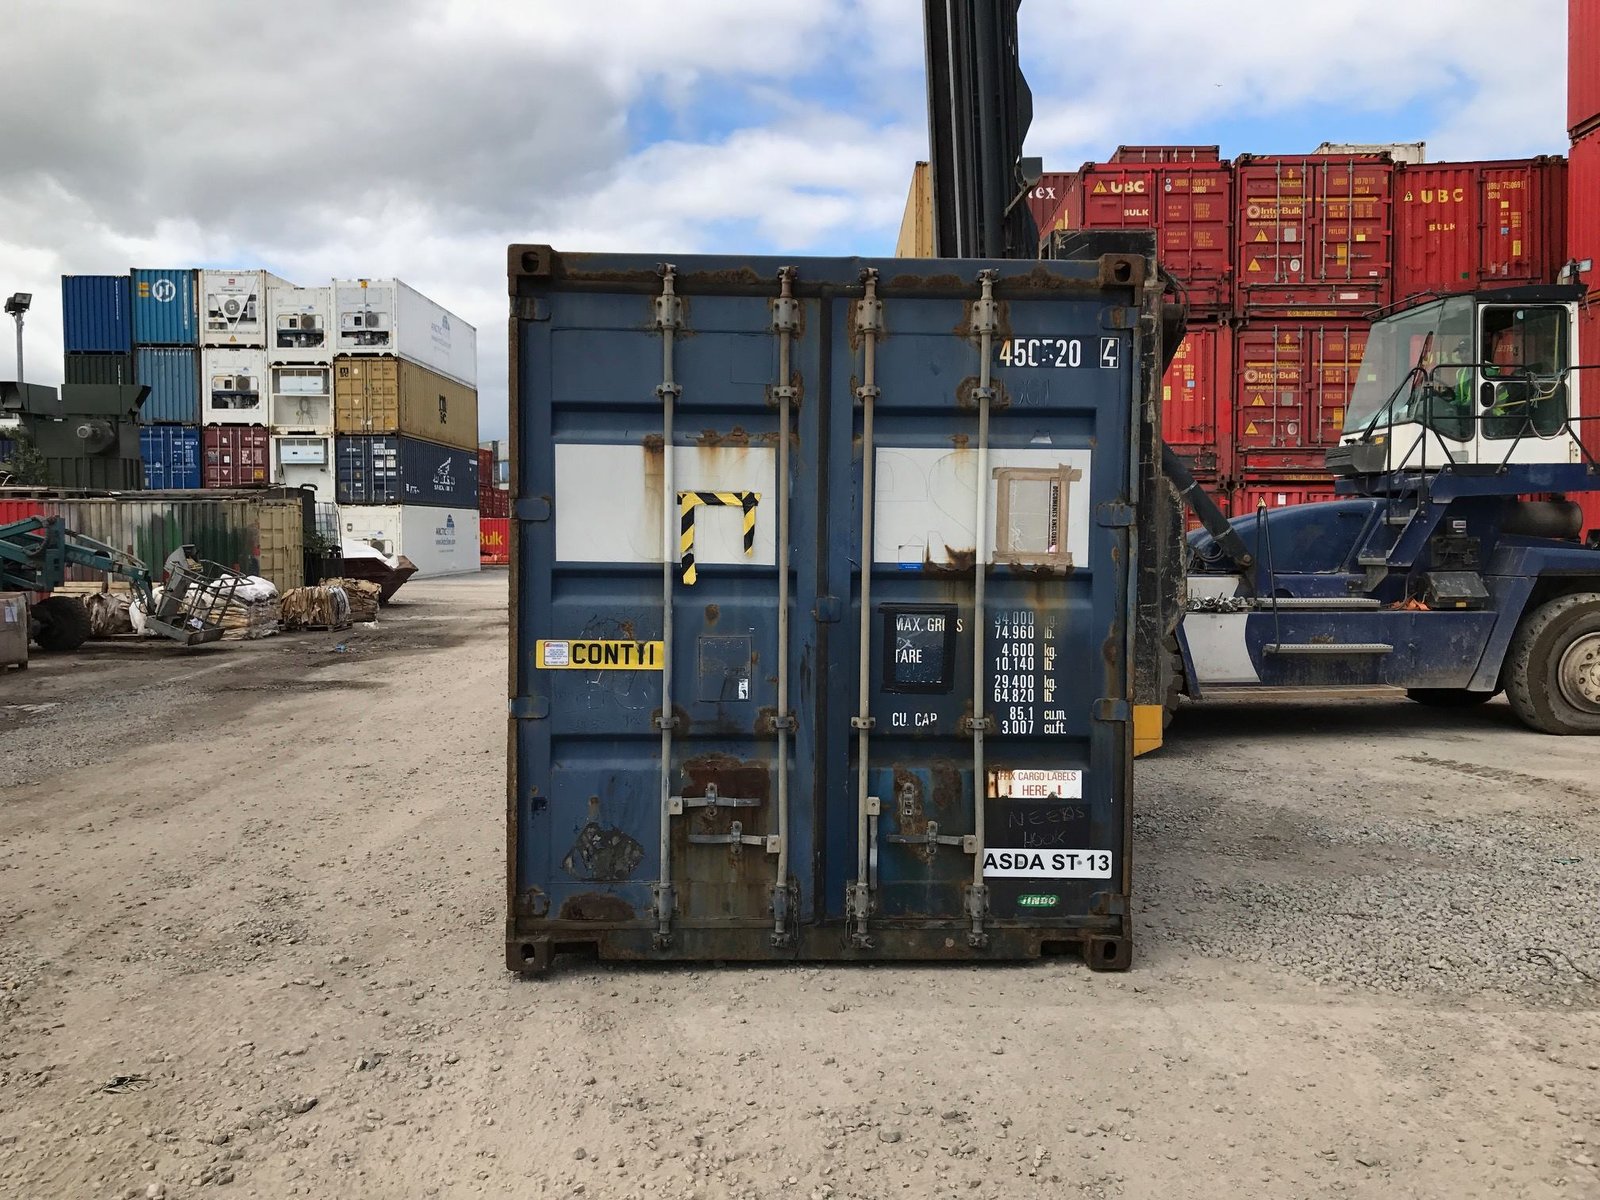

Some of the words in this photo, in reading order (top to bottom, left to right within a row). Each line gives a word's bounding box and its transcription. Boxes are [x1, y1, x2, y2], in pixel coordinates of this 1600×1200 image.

[1110, 180, 1145, 194] UBC
[1420, 188, 1464, 203] UBC
[1123, 208, 1149, 217] BULK
[1260, 206, 1302, 215] InterBulk
[1428, 223, 1456, 231] BULK
[1102, 339, 1117, 367] 4
[1258, 371, 1299, 380] InterBulk
[1051, 485, 1059, 518] DOCUMENTS
[994, 611, 1034, 626] 34.000
[994, 625, 1034, 639] 74.960
[1043, 626, 1055, 639] lb.
[895, 649, 922, 664] TARE
[1001, 642, 1034, 657] 4.600
[1043, 643, 1058, 661] kg.
[995, 656, 1034, 671] 10.140
[1043, 657, 1055, 671] lb.
[994, 674, 1034, 689] 29.400
[1043, 674, 1058, 691] kg.
[994, 688, 1034, 703] 64.820
[1043, 688, 1055, 703] lb.
[1009, 706, 1033, 720] 85.1
[1001, 719, 1034, 735] 3.007
[1018, 772, 1045, 781] CARGO
[1047, 772, 1077, 781] LABELS
[1022, 784, 1048, 797] HERE
[983, 853, 1045, 870] ASDA
[1052, 854, 1079, 870] ST
[1086, 854, 1110, 871] 13
